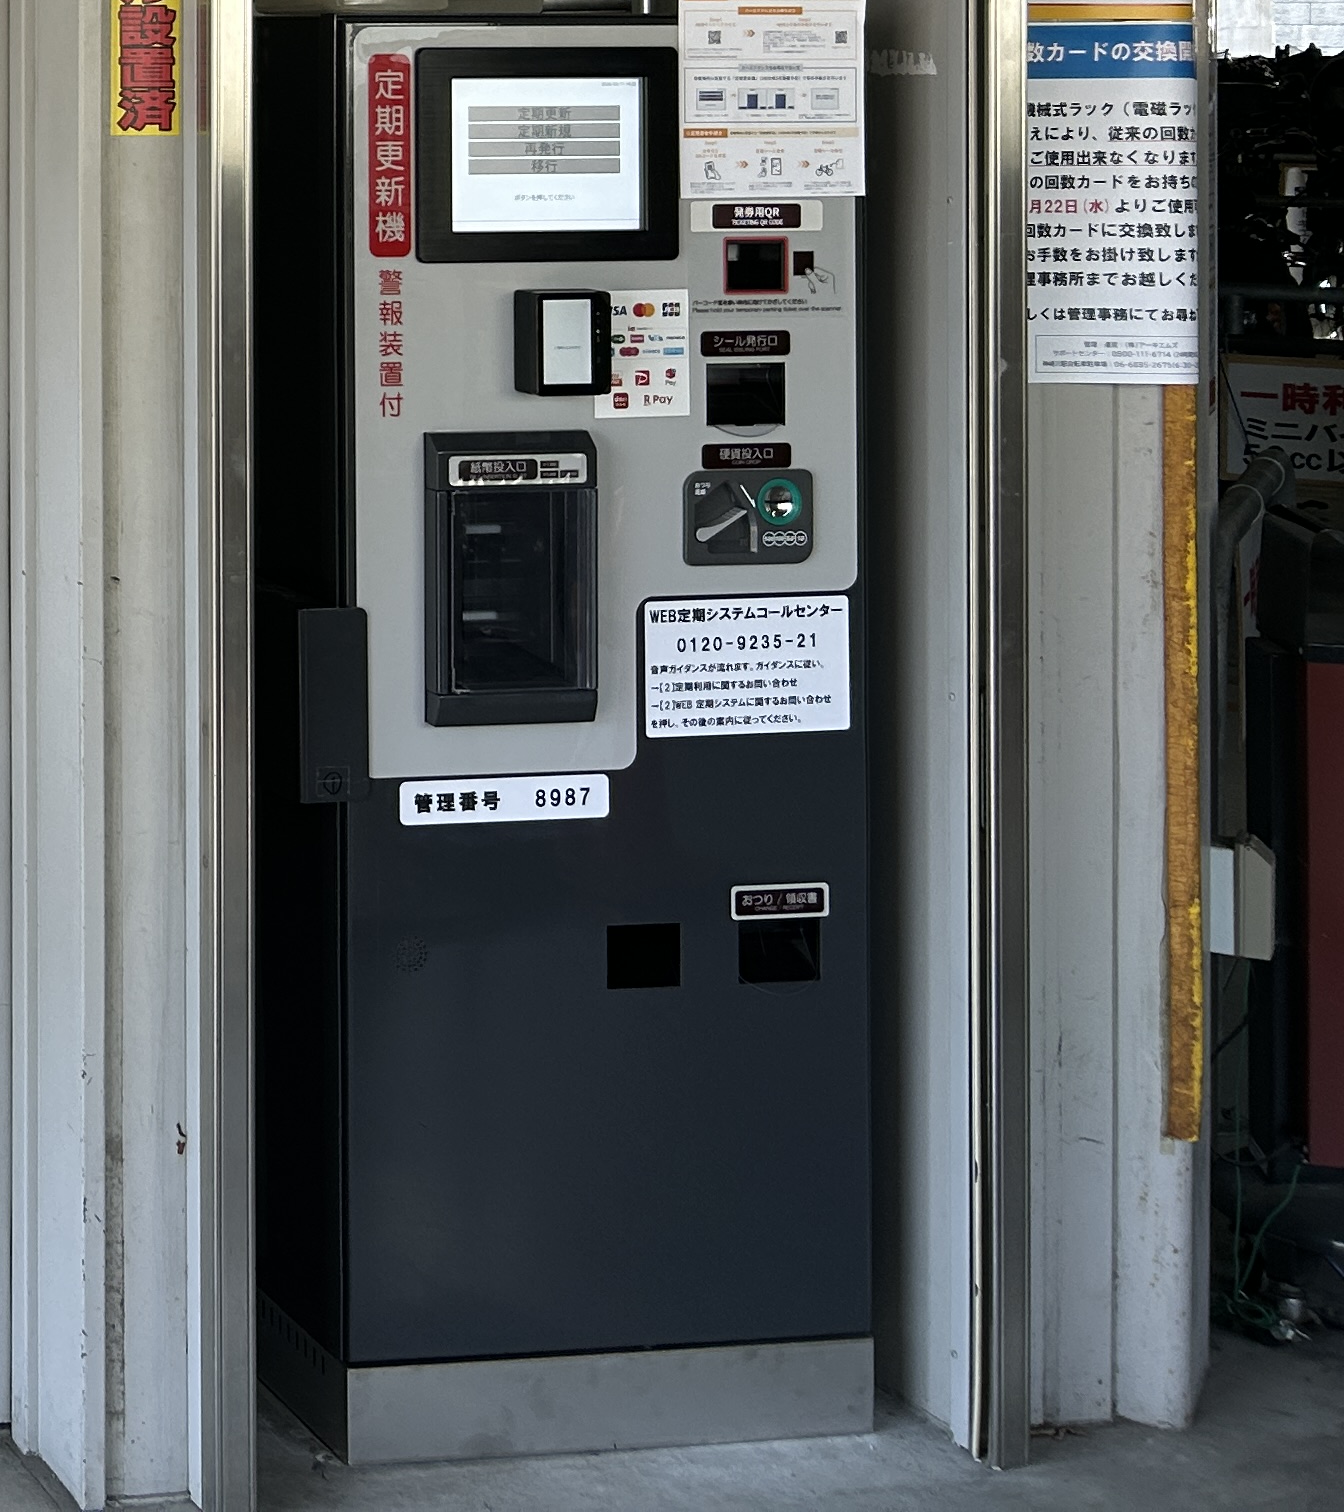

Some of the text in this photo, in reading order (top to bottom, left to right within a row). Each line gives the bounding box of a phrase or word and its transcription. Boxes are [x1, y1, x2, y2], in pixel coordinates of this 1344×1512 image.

[518, 107, 572, 121] 定期更新
[518, 124, 572, 139] 定期新規
[374, 69, 406, 243] 定期更新機
[525, 142, 565, 156] 再発行
[530, 160, 559, 173] 移行
[733, 206, 780, 219] 発券用QR
[379, 269, 404, 418] 警報装置付
[713, 335, 778, 348] シール発行口
[653, 395, 674, 405] Pay
[719, 448, 774, 460] 硬貨投入口
[470, 461, 527, 474] 紙幣投入口
[649, 603, 844, 624] WEB定期システムコールセンター
[676, 632, 817, 653] 0120-9235-21
[650, 713, 802, 729] を押し、その後の案内に従ってください。
[414, 787, 592, 814] 管理番号 8987
[742, 894, 773, 907] おつり
